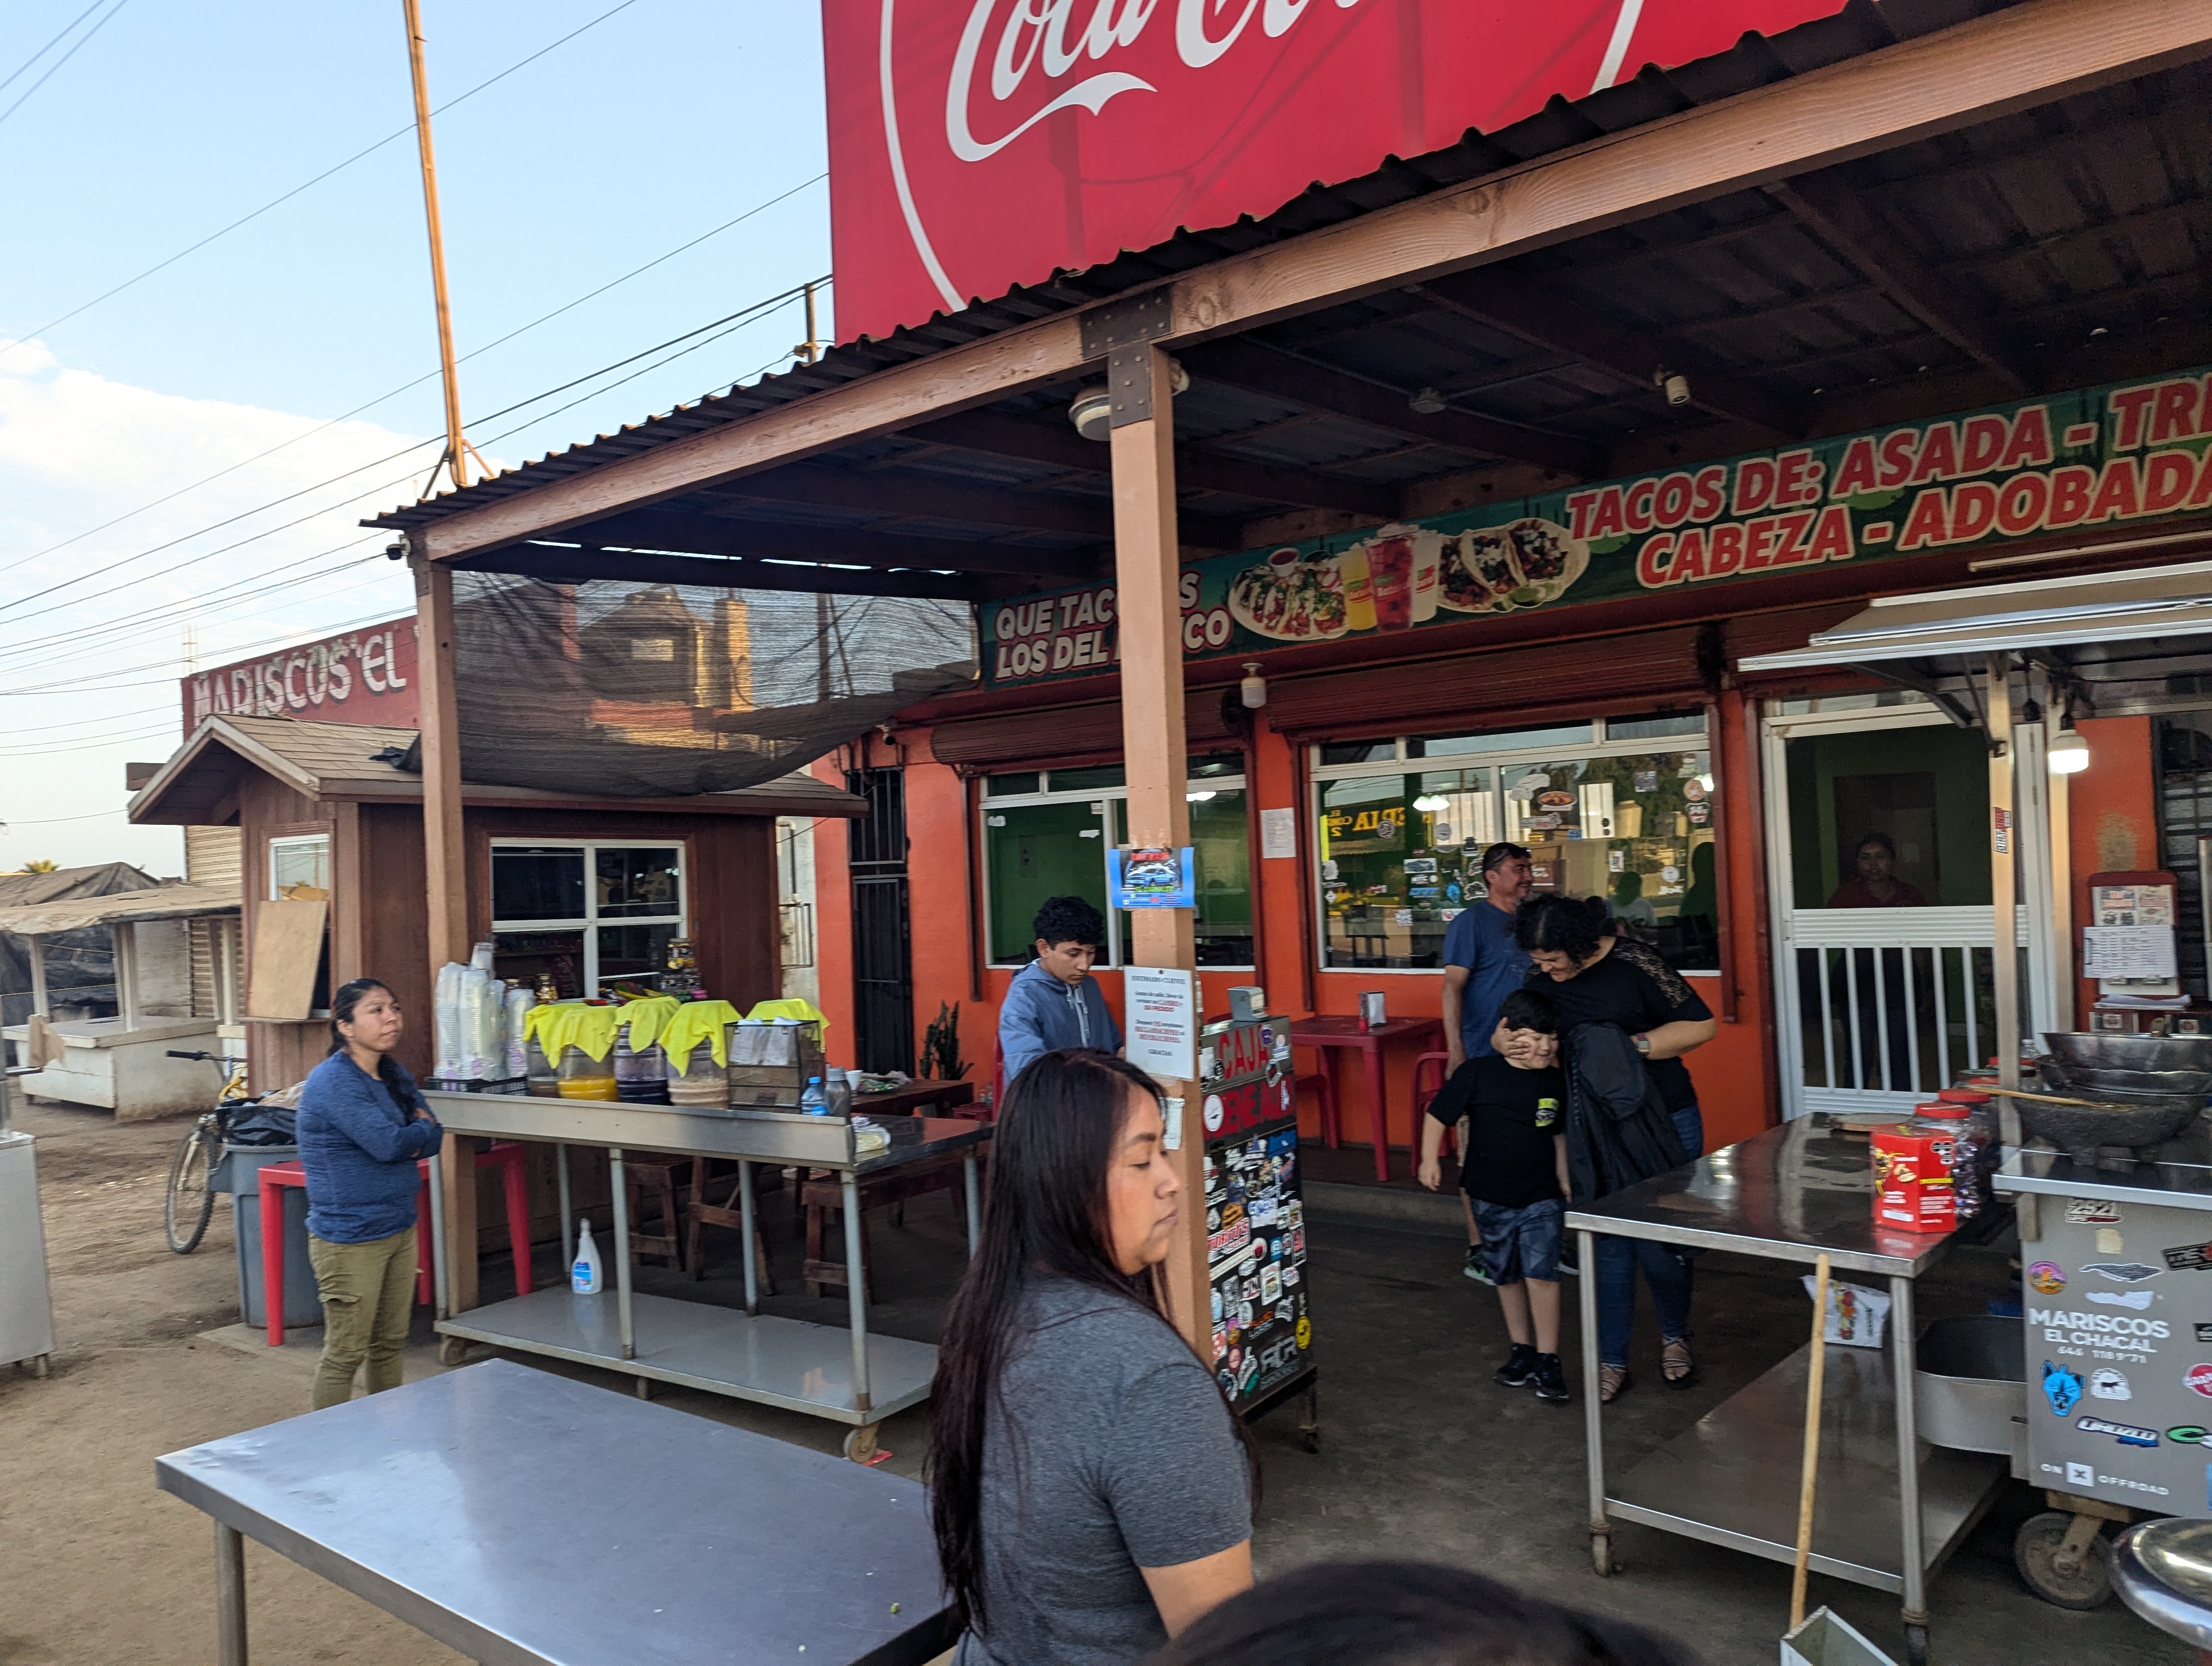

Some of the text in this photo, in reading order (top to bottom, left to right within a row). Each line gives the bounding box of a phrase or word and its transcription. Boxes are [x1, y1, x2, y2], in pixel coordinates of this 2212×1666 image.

[1566, 465, 1726, 541] TACOS
[1733, 448, 1825, 515] DE:
[1831, 405, 2053, 499] ASADA
[1636, 504, 1853, 588] CABEZA
[996, 599, 1054, 640] QUE
[995, 639, 1050, 678] LOS
[1052, 630, 1110, 670] DEL
[1218, 1023, 1270, 1080] CAJA
[2028, 1308, 2171, 1339] MARISCOS
[2043, 1328, 2158, 1353] EL CHACAL
[2040, 1463, 2063, 1475] ON
[2097, 1475, 2169, 1496] OFFROAD
